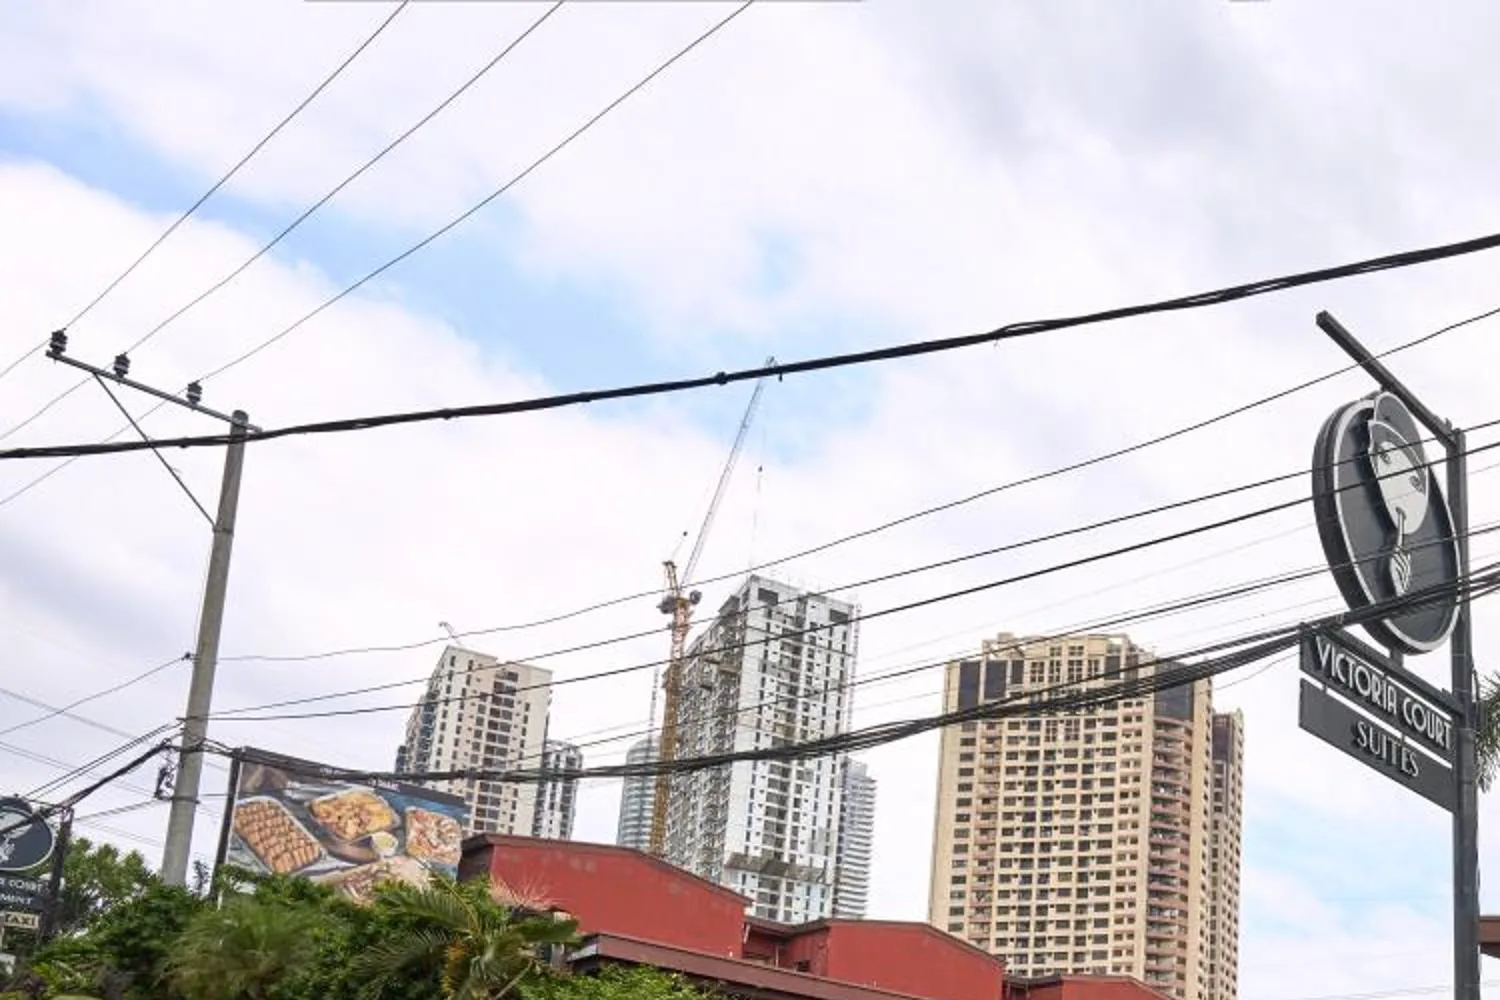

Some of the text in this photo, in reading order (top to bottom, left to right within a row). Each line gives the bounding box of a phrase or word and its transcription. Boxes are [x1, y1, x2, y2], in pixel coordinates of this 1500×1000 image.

[1315, 634, 1452, 750] VICTORIA COURT
[1356, 720, 1419, 777] SUITES
